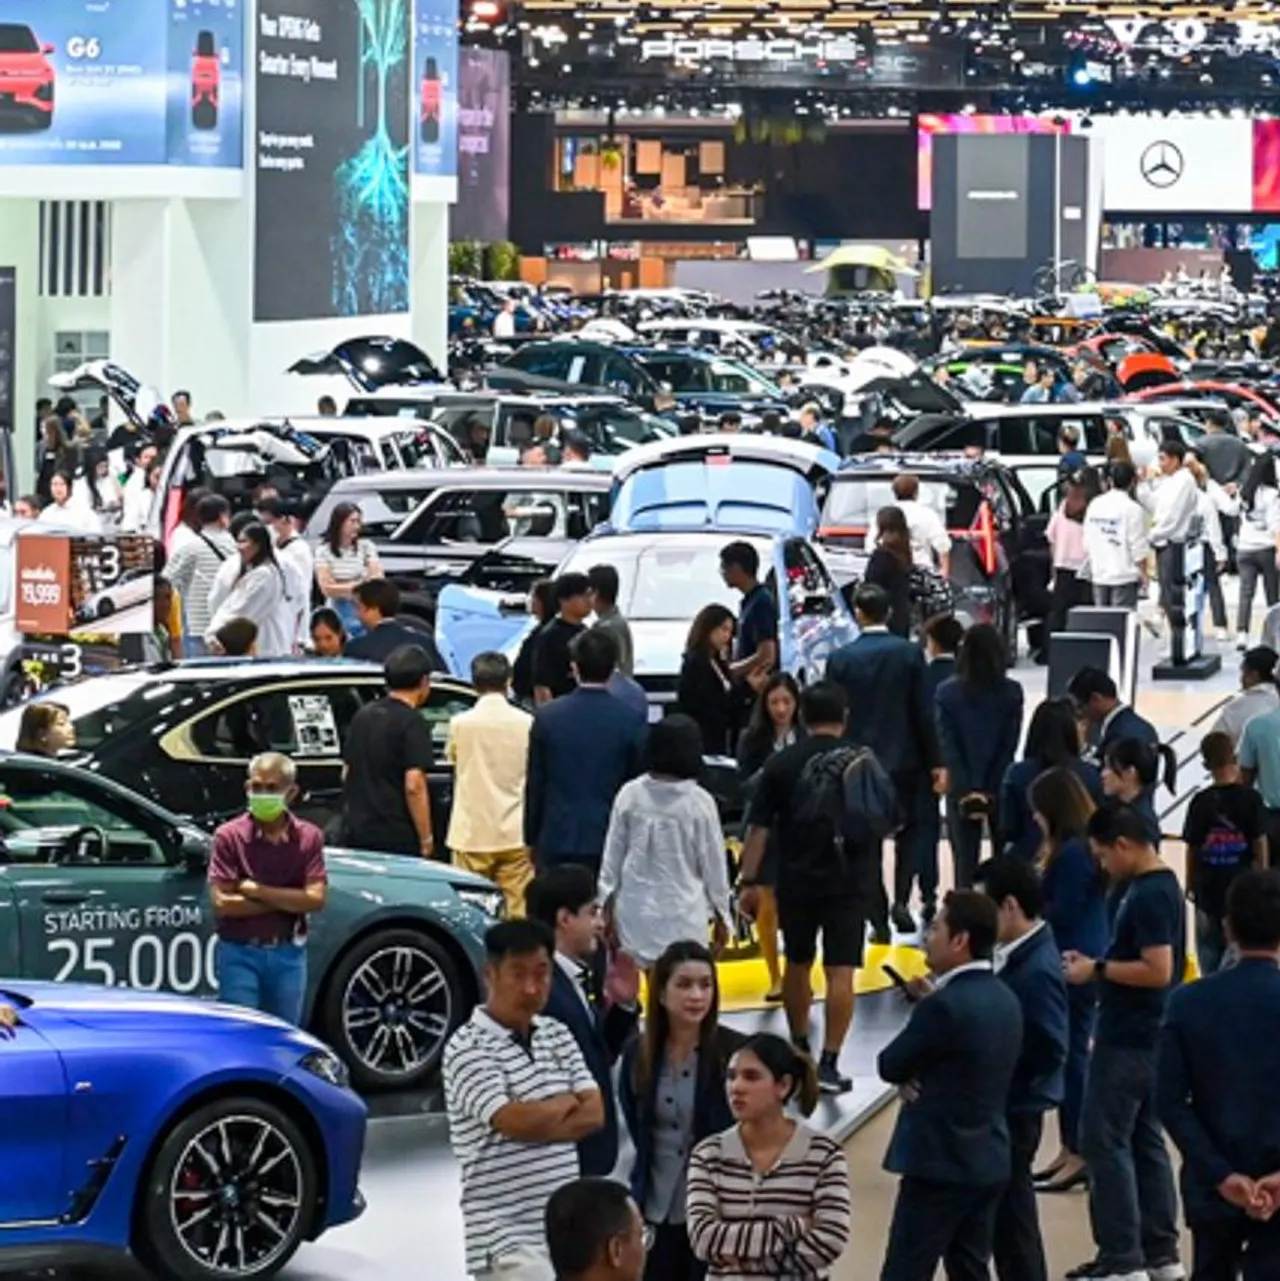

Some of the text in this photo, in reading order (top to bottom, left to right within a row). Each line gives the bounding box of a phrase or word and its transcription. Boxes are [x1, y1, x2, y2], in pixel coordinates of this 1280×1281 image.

[66, 36, 101, 59] G6
[641, 39, 861, 61] PORSCHE
[101, 545, 120, 580] 3
[59, 643, 83, 678] 3
[44, 904, 201, 935] STARTING FROM
